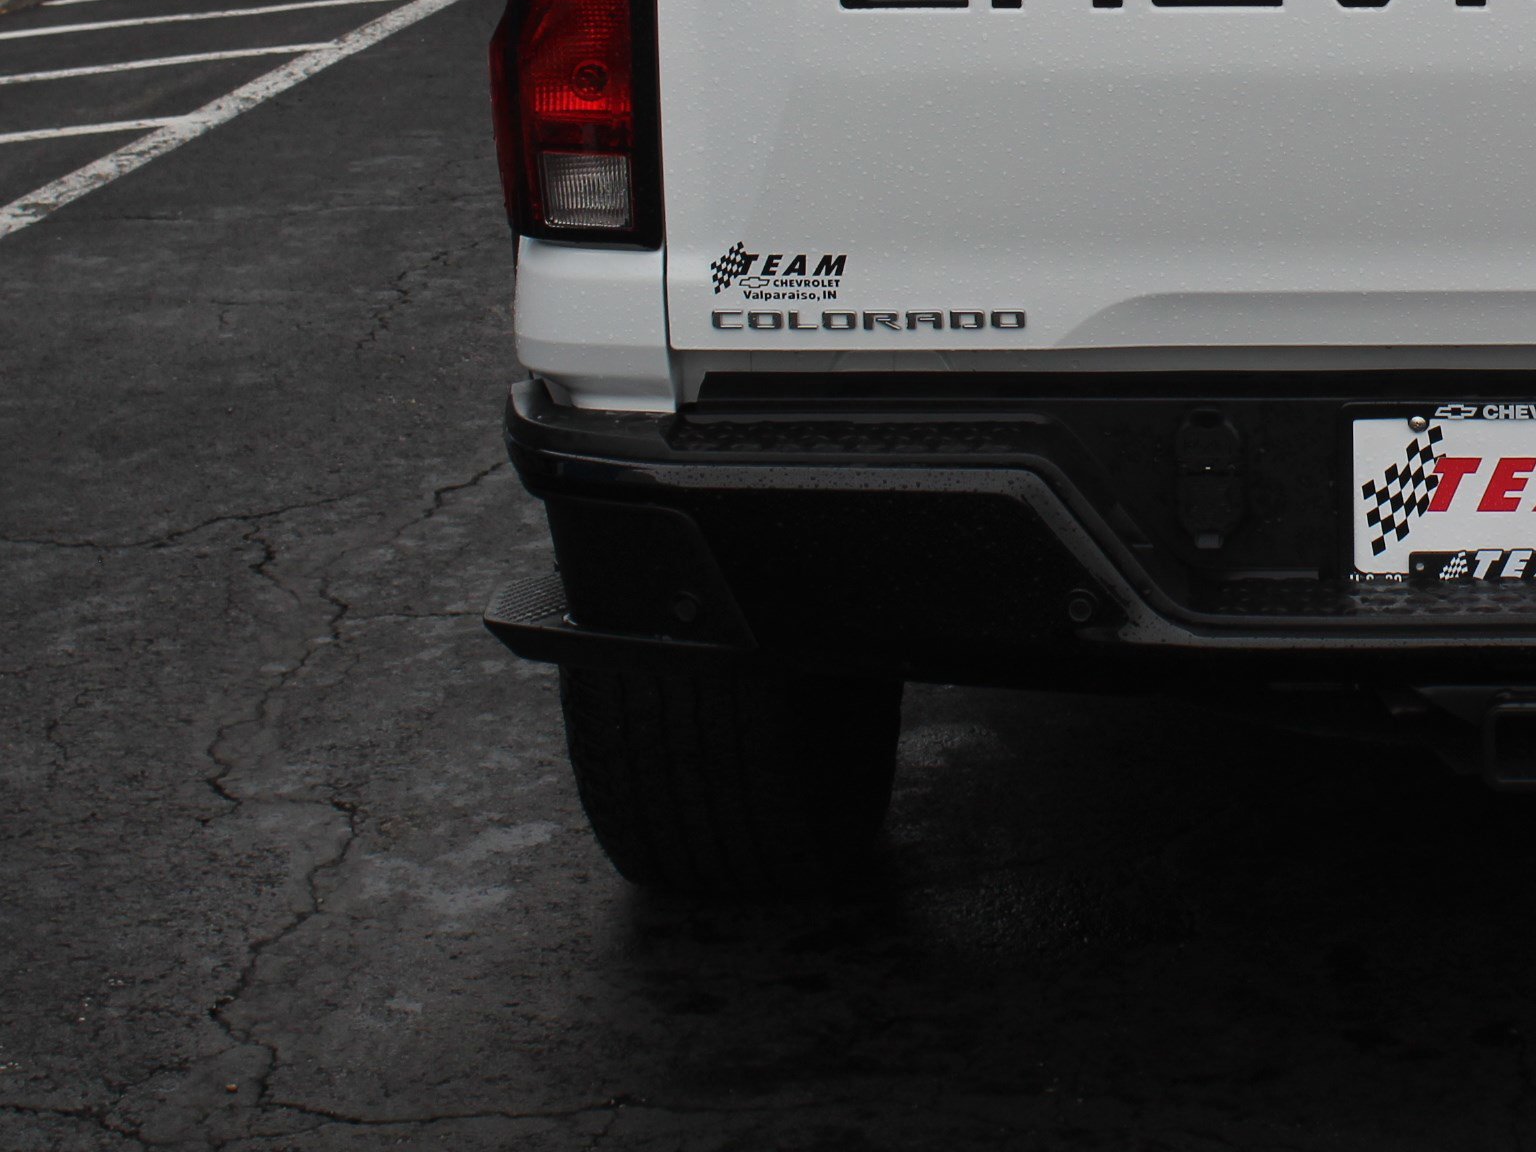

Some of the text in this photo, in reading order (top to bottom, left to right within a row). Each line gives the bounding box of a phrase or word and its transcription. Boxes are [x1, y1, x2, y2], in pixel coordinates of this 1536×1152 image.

[740, 253, 847, 276] TEAM
[773, 278, 841, 288] CHEVROLET
[743, 289, 837, 301] Valparaiso, IN
[711, 309, 1027, 331] COLORADO
